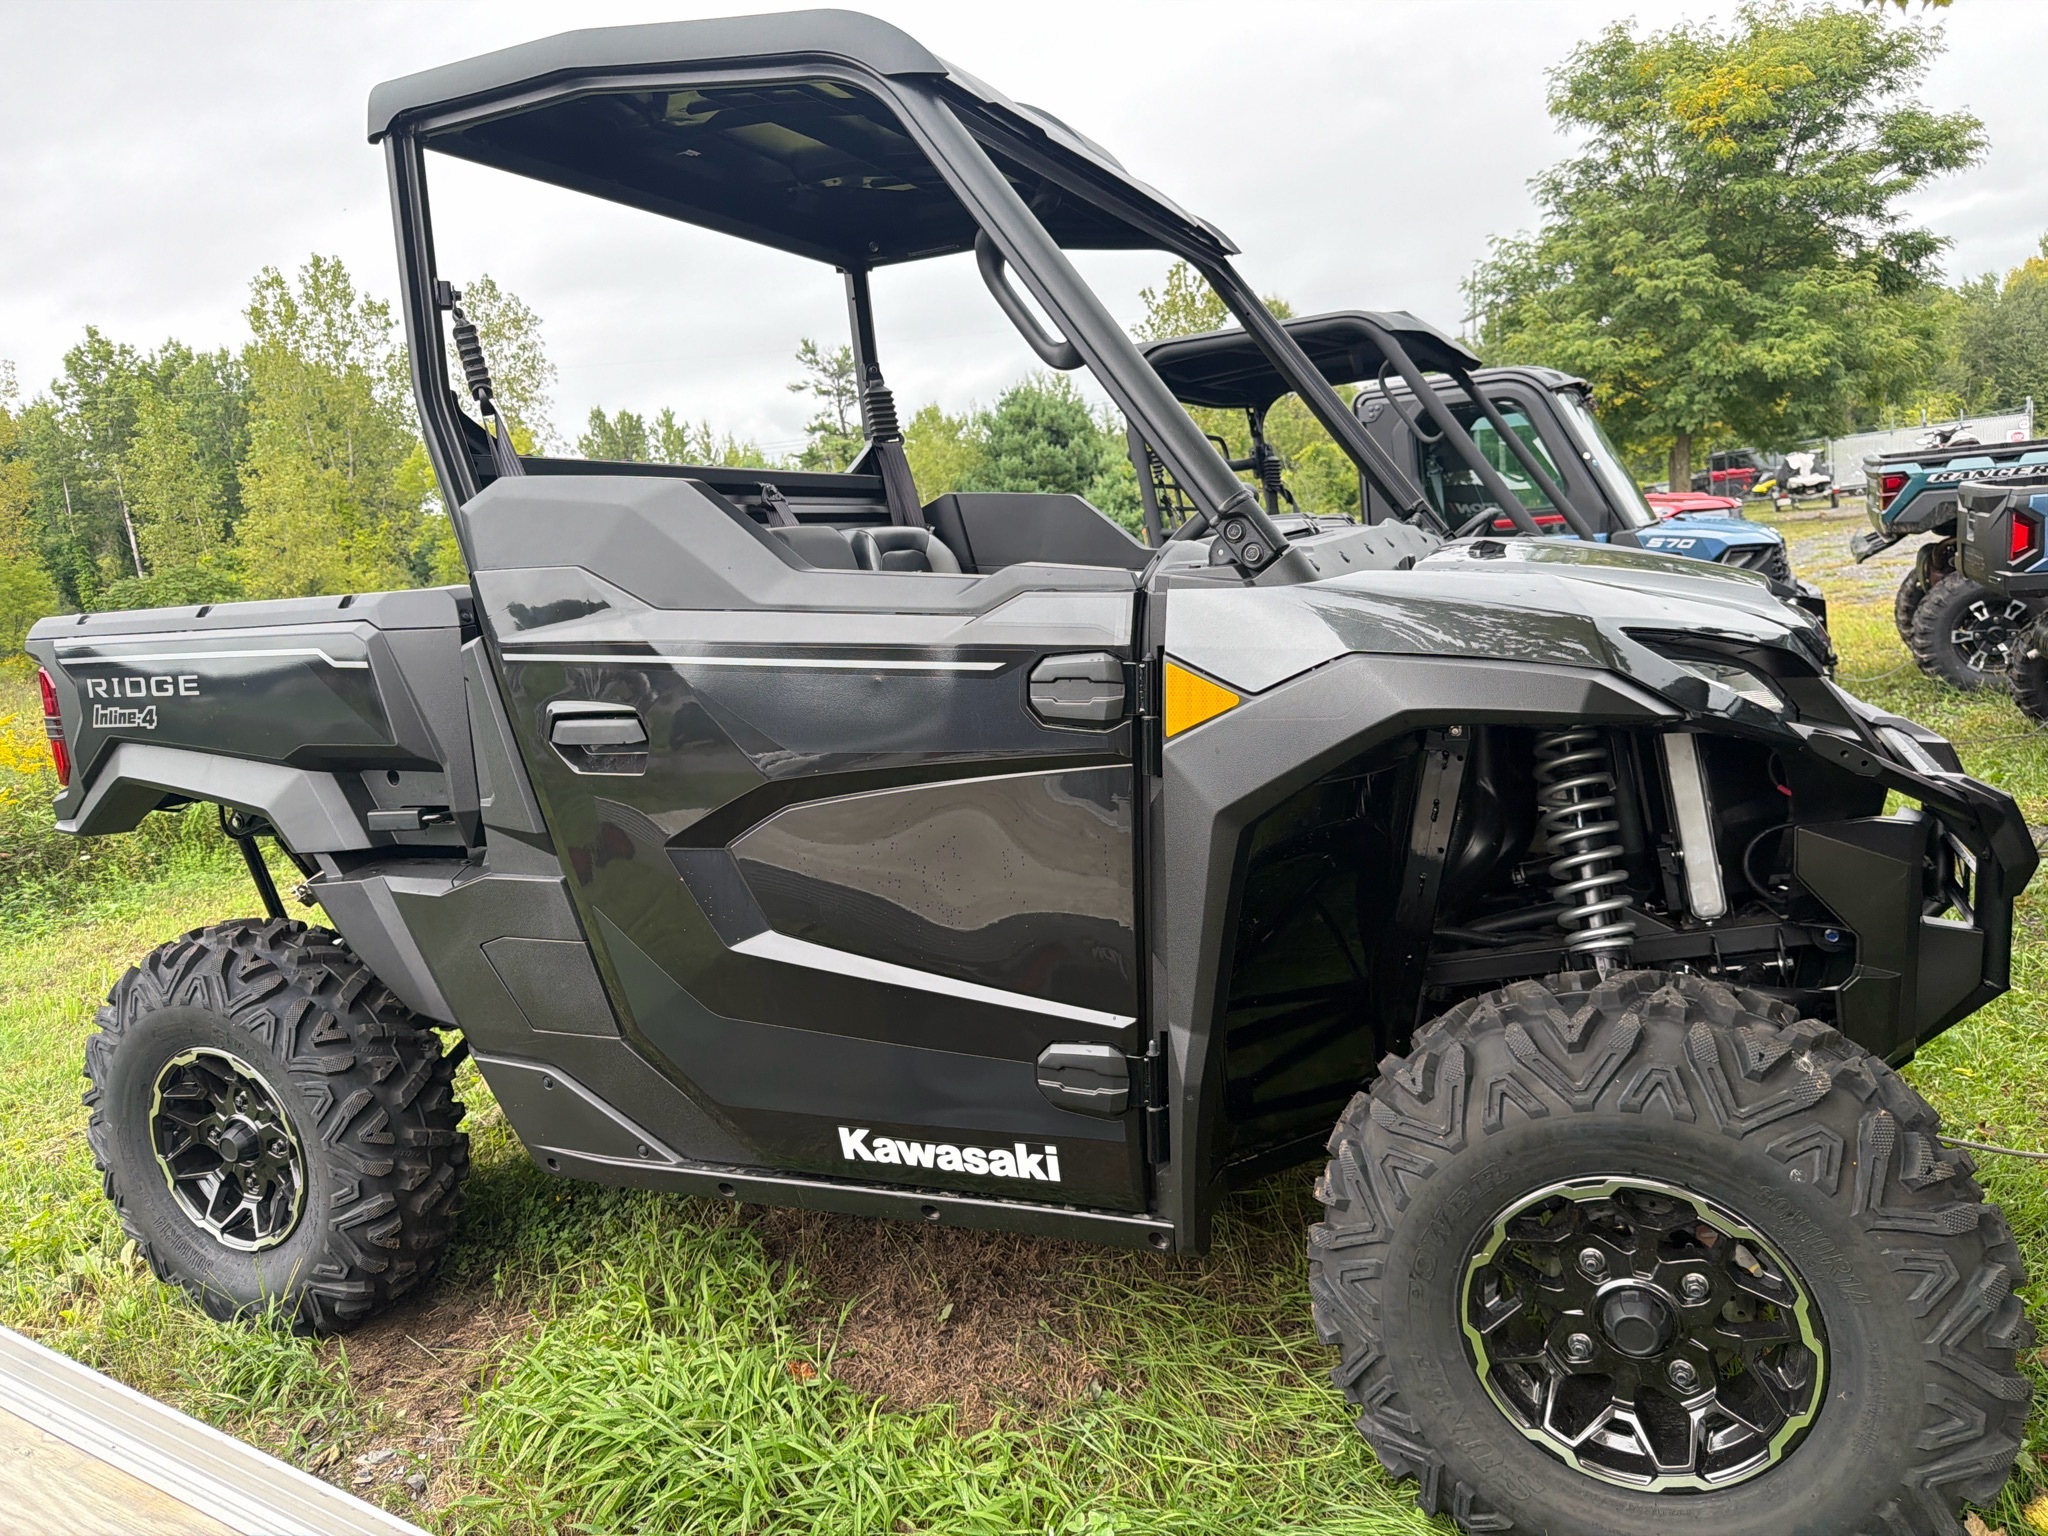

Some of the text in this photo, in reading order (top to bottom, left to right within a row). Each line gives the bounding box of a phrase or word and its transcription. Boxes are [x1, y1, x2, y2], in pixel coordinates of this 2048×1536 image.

[1928, 465, 2048, 483] RANGER
[86, 674, 200, 698] RIDGE
[838, 1126, 1061, 1182] Kawasaki
